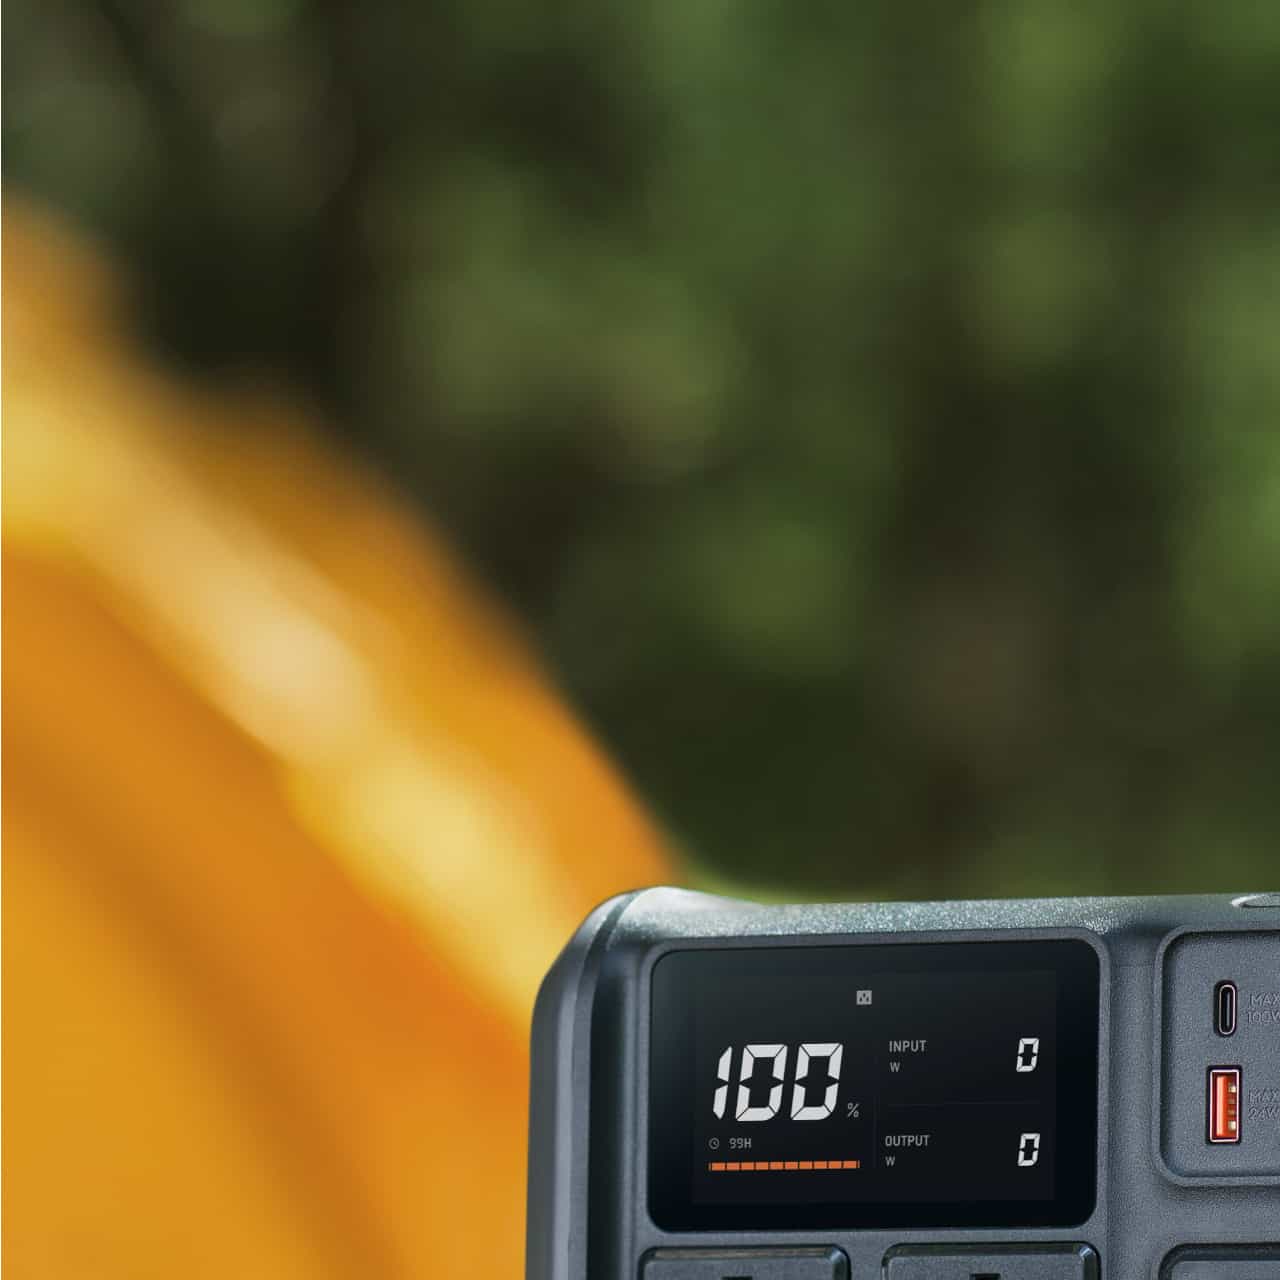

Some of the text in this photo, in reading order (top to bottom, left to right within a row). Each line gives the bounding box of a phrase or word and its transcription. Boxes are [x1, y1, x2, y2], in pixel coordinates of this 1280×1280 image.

[1250, 992, 1280, 1007] MAX
[888, 1039, 928, 1053] INPUT
[1016, 1037, 1040, 1073] 0
[889, 1061, 901, 1073] W
[1248, 1088, 1280, 1103] MAX
[729, 1137, 752, 1150] 99H
[885, 1134, 931, 1148] OUTPUT
[1018, 1132, 1041, 1167] 0
[885, 1155, 896, 1167] W
